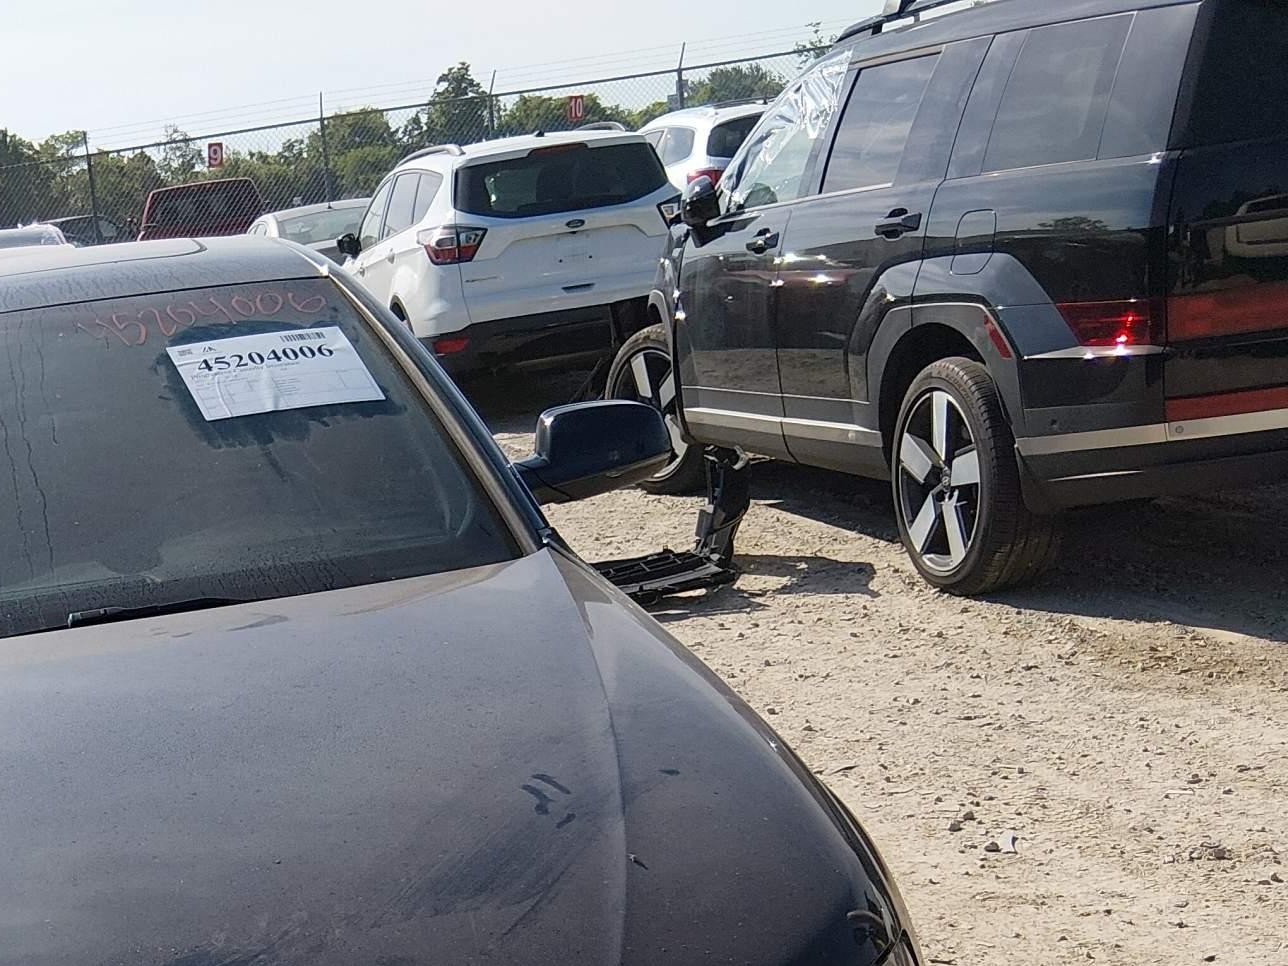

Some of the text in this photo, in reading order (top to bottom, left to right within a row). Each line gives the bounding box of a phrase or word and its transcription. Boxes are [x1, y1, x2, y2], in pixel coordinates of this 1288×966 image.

[570, 98, 582, 117] 10
[210, 145, 222, 165] 9
[77, 292, 328, 346] 45204006
[198, 343, 334, 372] 45204006
